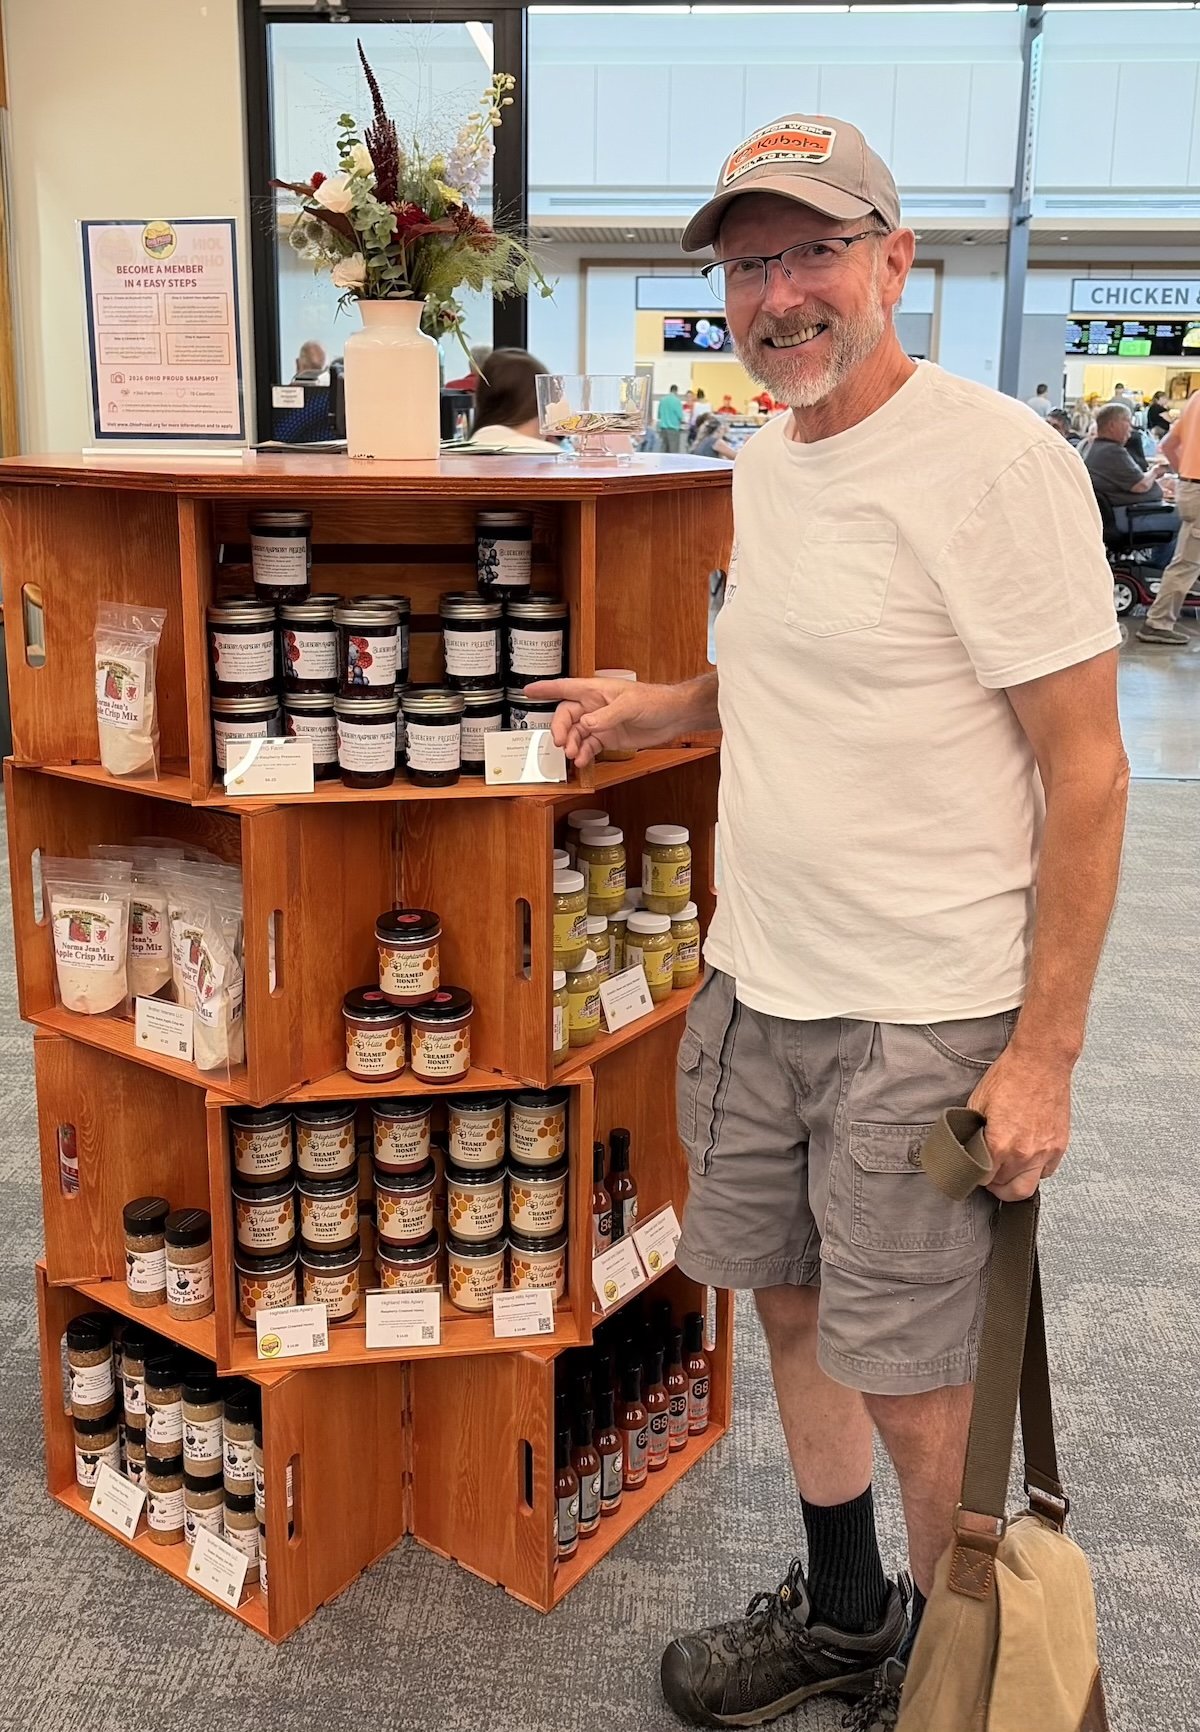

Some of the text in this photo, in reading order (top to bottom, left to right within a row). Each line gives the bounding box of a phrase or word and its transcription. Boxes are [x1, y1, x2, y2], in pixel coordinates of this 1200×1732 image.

[789, 124, 824, 134] WORK
[757, 135, 823, 149] Kubota
[116, 266, 154, 274] BECOME
[164, 265, 204, 273] MEMBER
[124, 280, 197, 288] IN 4 EASY STEPS
[1091, 288, 1189, 305] CHICKEN
[105, 708, 138, 721] Crisp Mix
[62, 942, 106, 953] Norma Jean's
[146, 943, 162, 951] Mix
[75, 951, 95, 962] Crisp
[513, 1132, 539, 1142] CREAMED
[515, 1139, 534, 1148] HONEY
[251, 1150, 283, 1159] CREAMED
[256, 1156, 279, 1165] HONEY
[398, 1214, 427, 1224] CREAMED
[471, 1211, 499, 1220] CREAMED
[470, 1283, 498, 1292] CREAMED
[694, 1381, 709, 1395] 88
[670, 1399, 686, 1410] 88
[652, 1416, 668, 1430] 88
